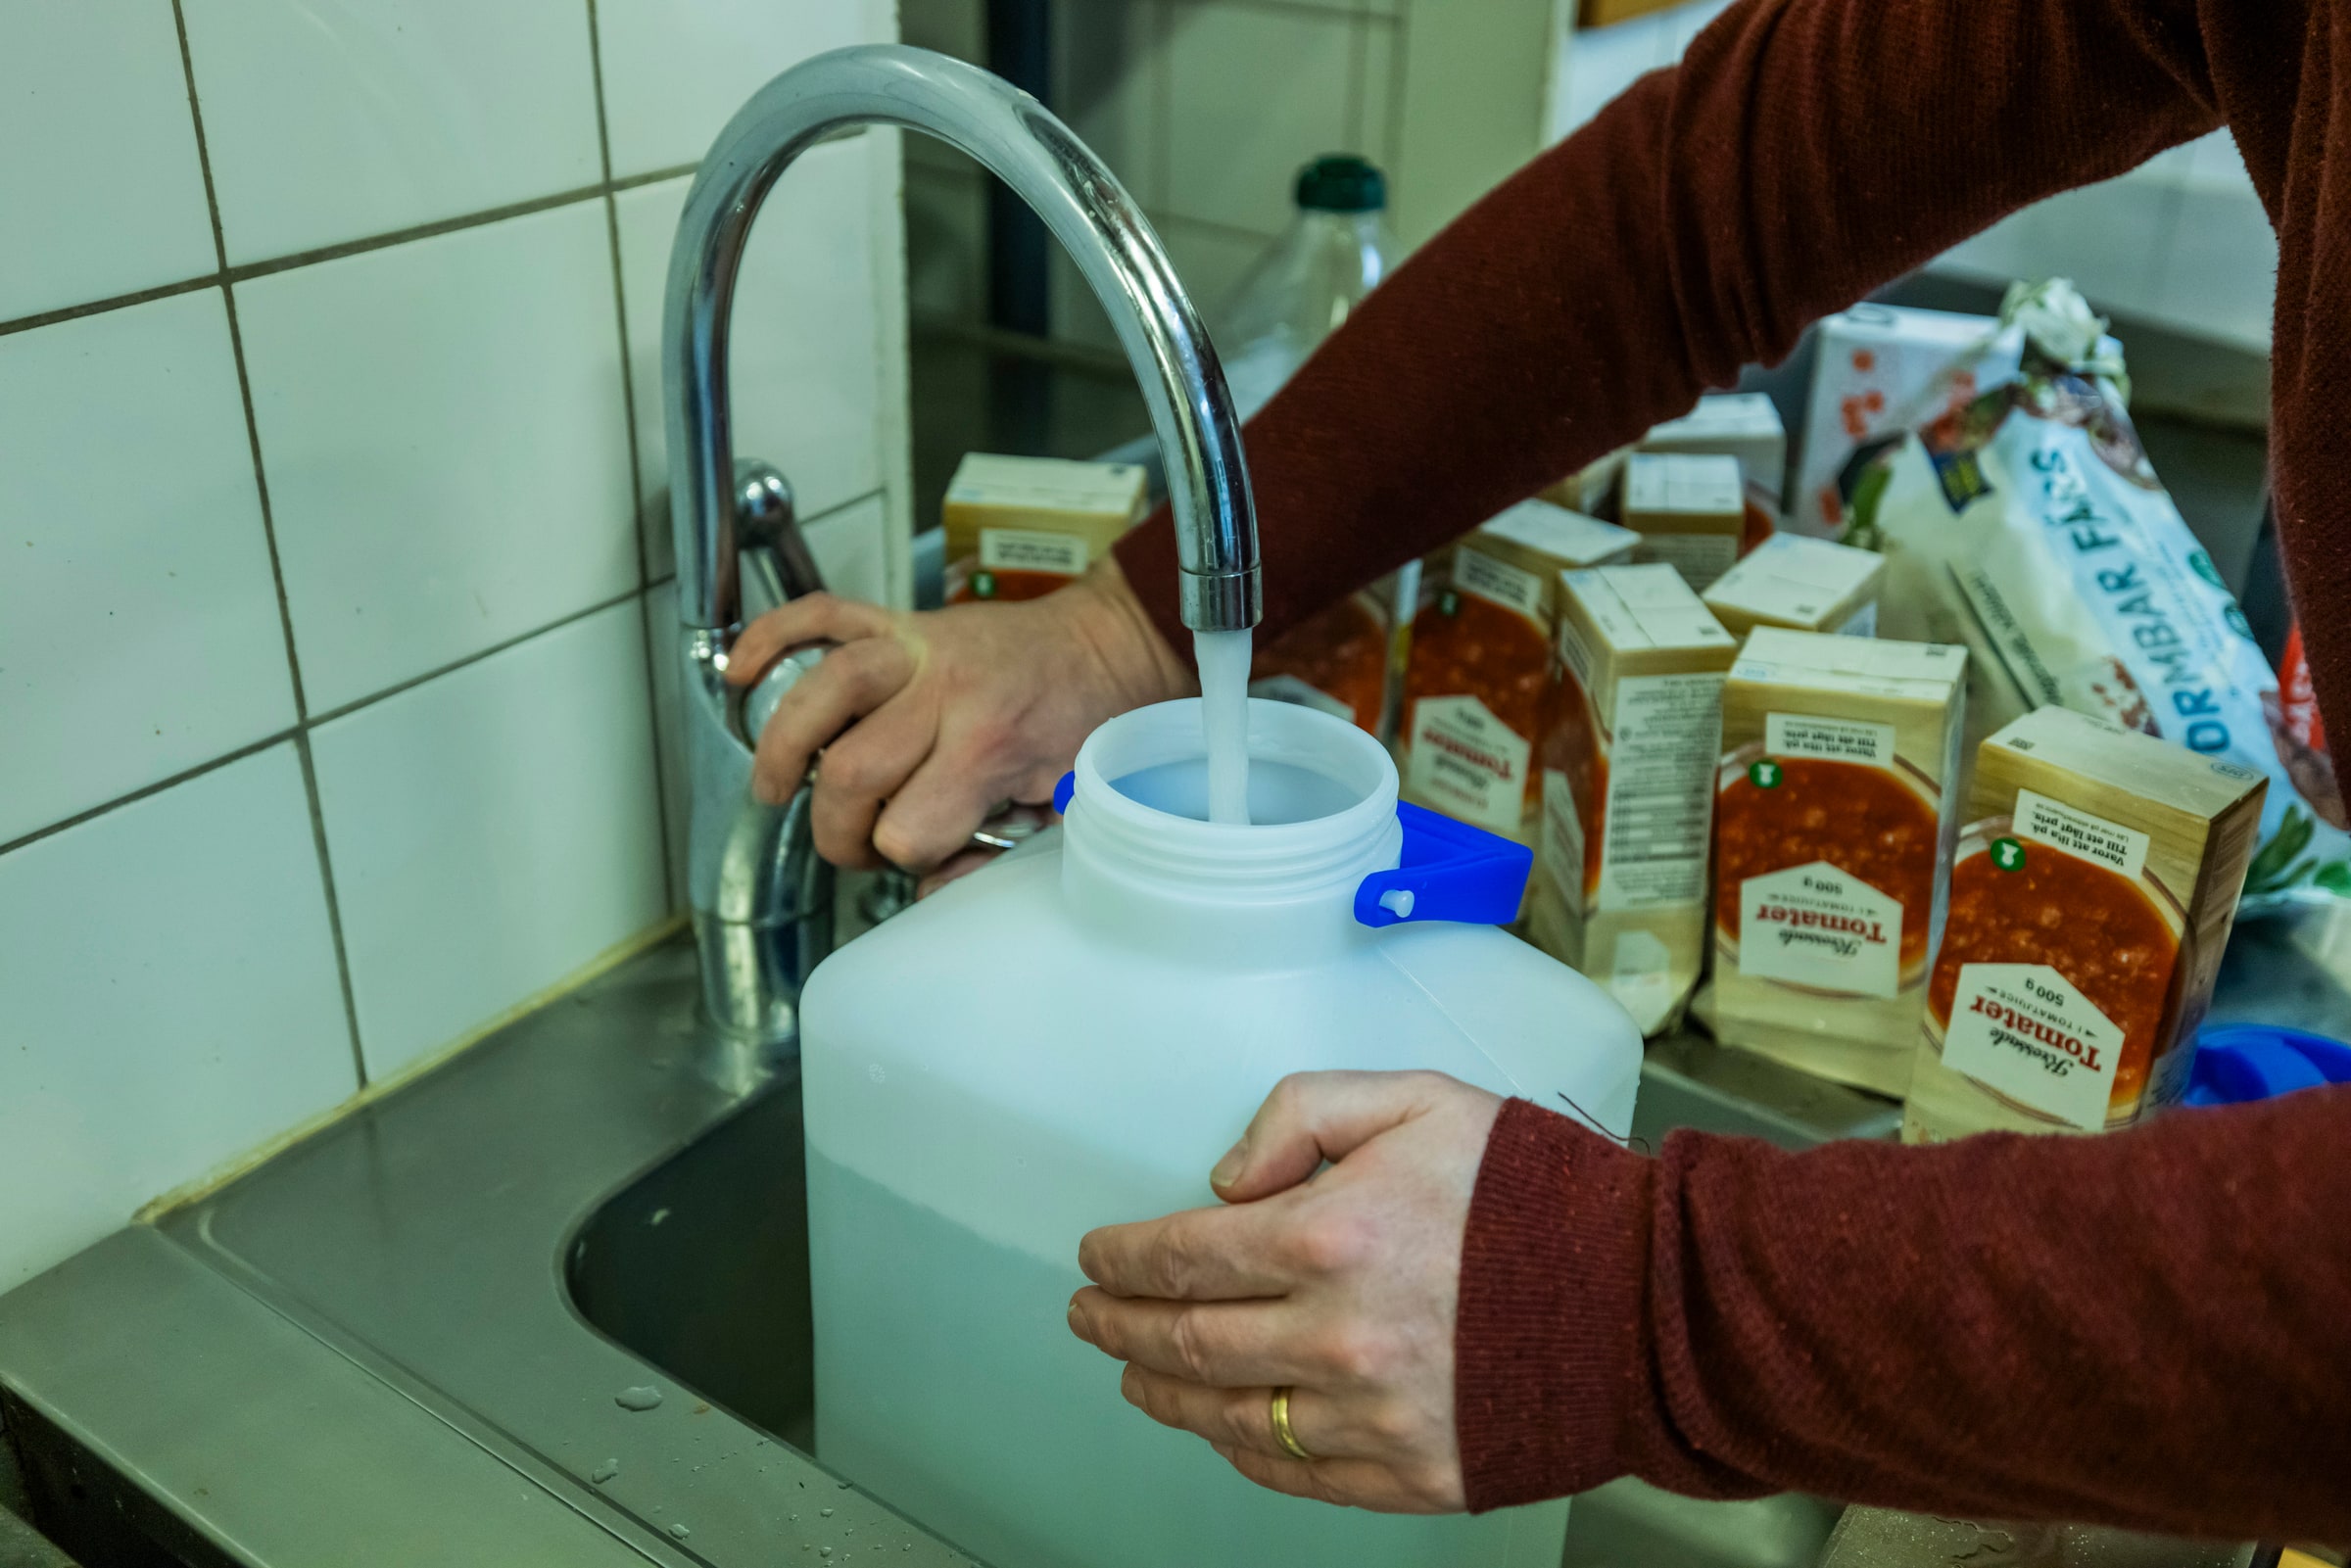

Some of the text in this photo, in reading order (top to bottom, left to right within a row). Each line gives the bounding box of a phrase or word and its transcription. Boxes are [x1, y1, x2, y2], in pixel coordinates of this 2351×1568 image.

[2050, 830, 2069, 845] lita
[2061, 823, 2084, 839] lågt
[2087, 832, 2104, 844] ett
[2073, 839, 2089, 851] att
[2107, 840, 2127, 855] Till
[2092, 846, 2125, 866] Varor
[1804, 876, 1843, 895] 500 g
[1756, 904, 1887, 945] Tomater
[2026, 977, 2064, 1007] 500 g
[1999, 990, 2072, 1029] TOMATJUICE
[1969, 994, 2101, 1072] Tomater
